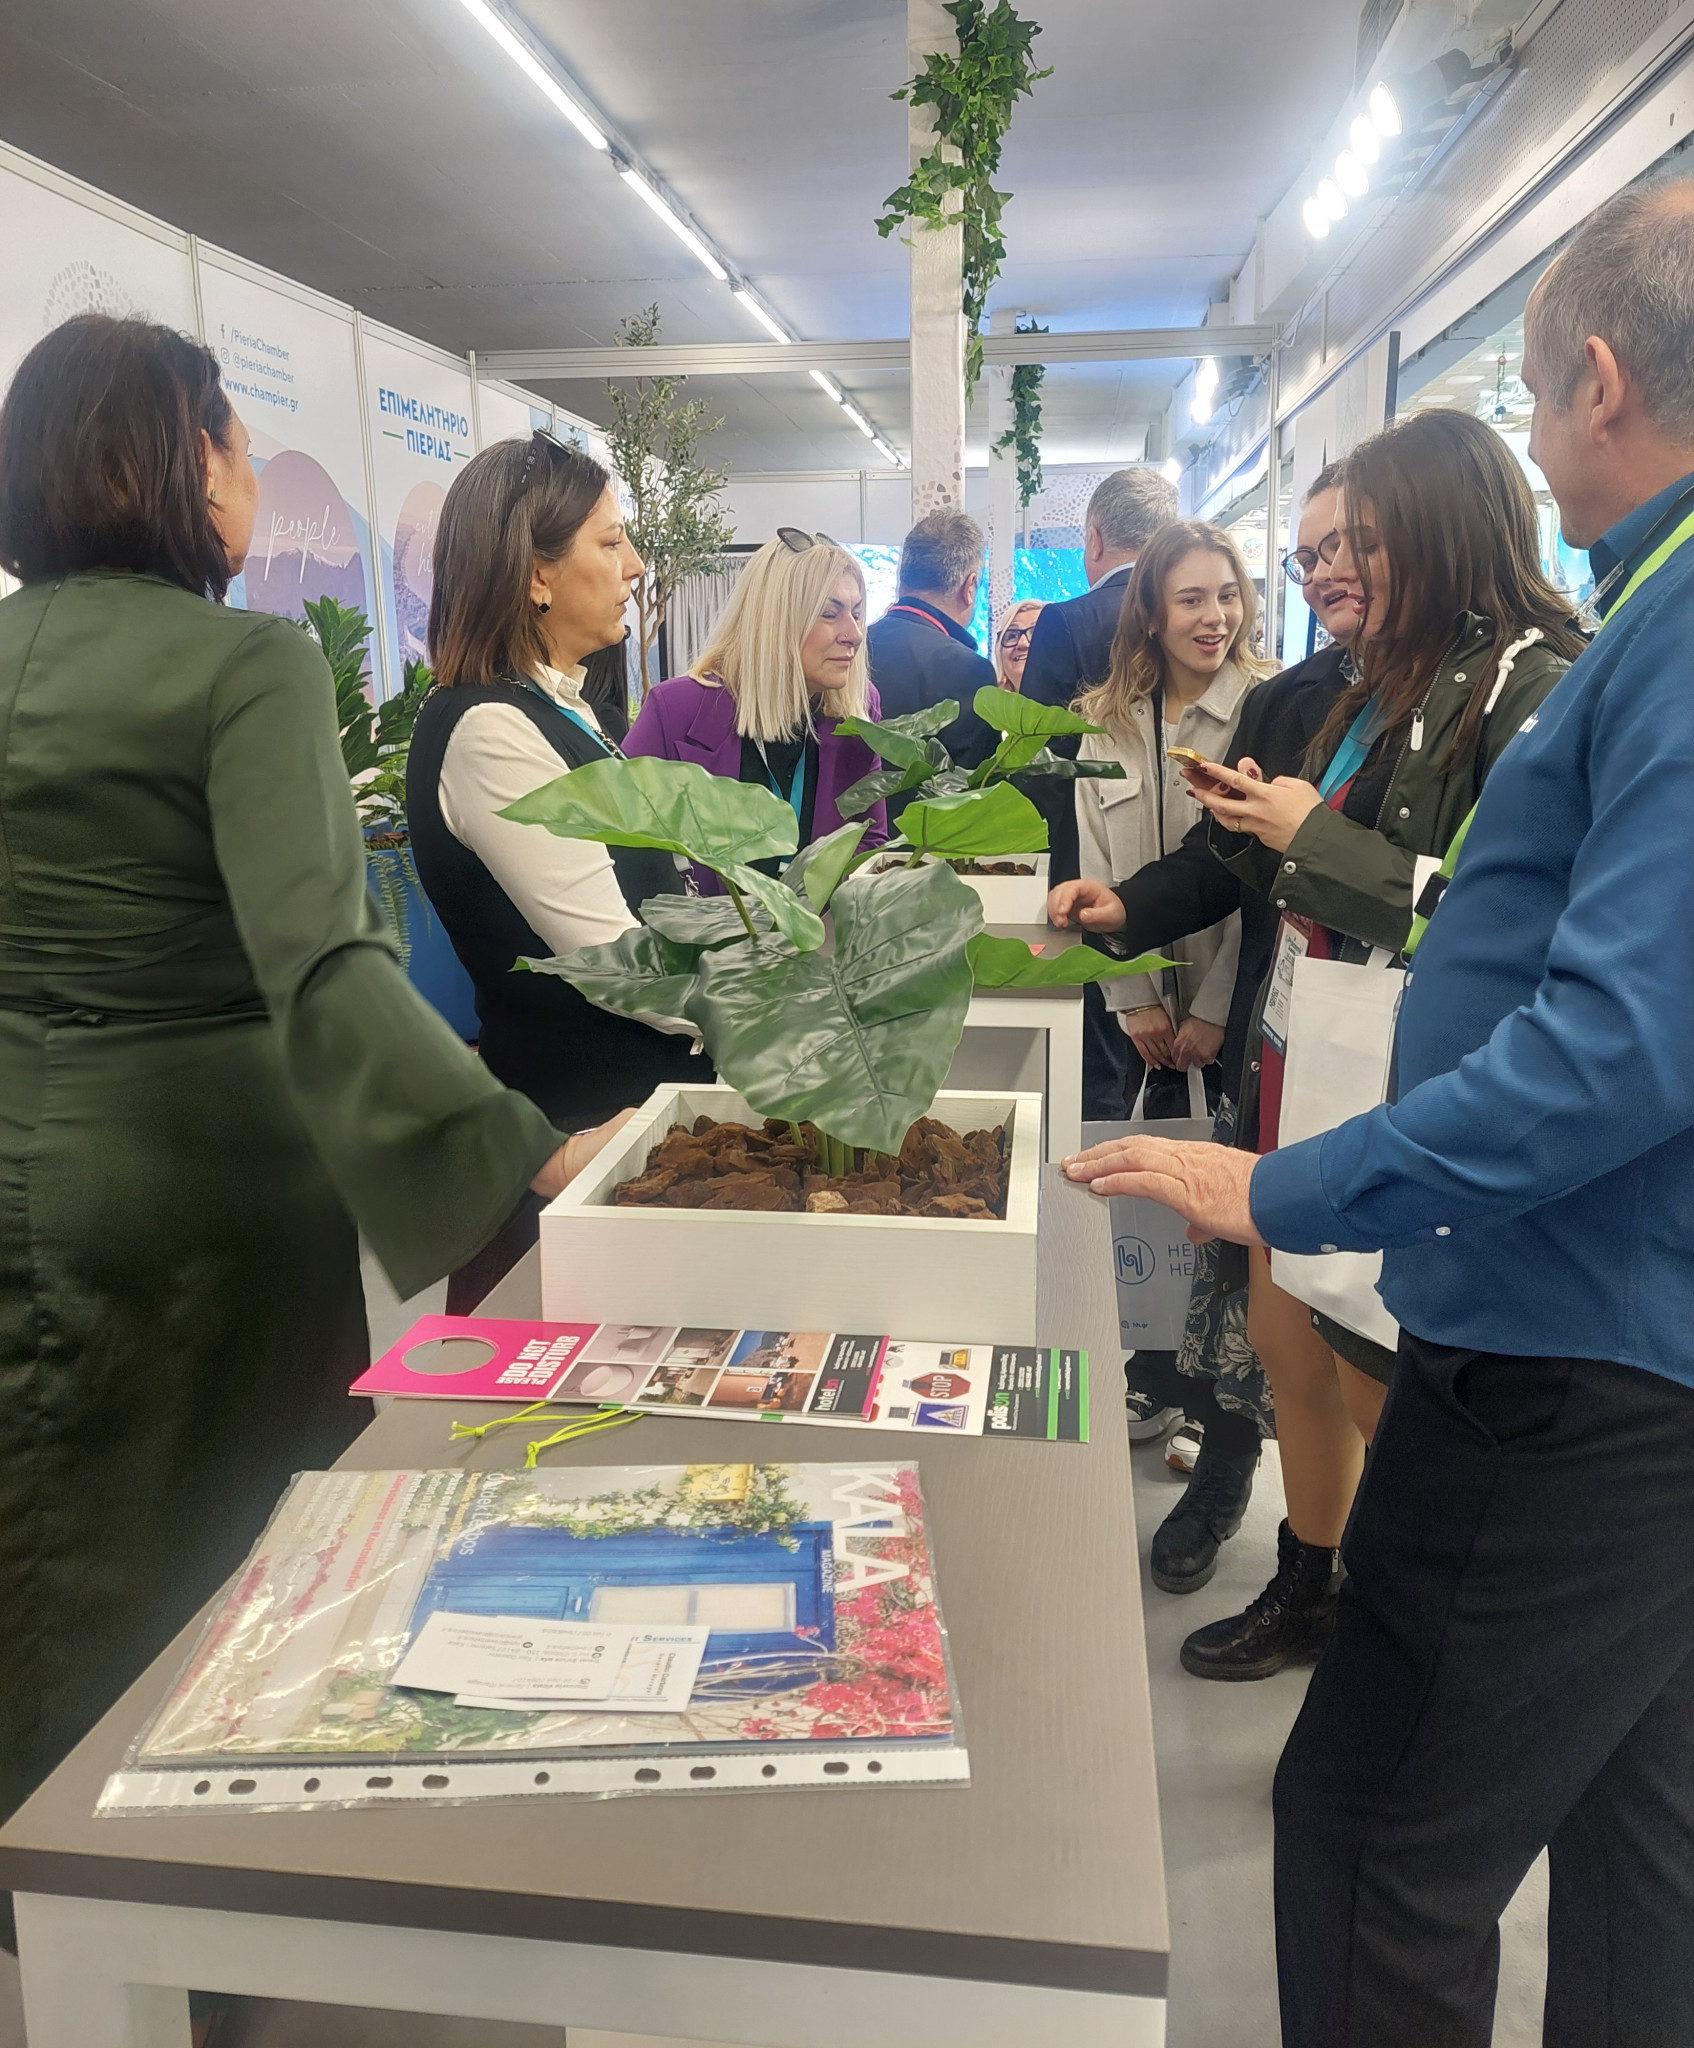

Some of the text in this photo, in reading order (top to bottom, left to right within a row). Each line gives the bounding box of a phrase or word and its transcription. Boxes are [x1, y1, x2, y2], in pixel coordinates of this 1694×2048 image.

[231, 327, 289, 360] /PieriaChamber
[233, 352, 294, 384] @pieriachamber
[224, 379, 299, 412] www.champier.gr
[379, 387, 469, 438] ΕΠΙΜΕΛΗΤΗΡΙΟ
[406, 428, 452, 462] ΠΙΕΡΙΑΣ
[264, 504, 341, 584] people
[1168, 1243, 1193, 1258] HE
[1170, 1262, 1194, 1278] HE
[501, 1338, 551, 1378] DO NOT
[528, 1335, 580, 1378] DISTURB
[494, 1376, 548, 1386] PLEASE
[929, 1375, 953, 1398] STOP
[458, 1512, 493, 1557] Lebos
[830, 1467, 910, 1594] KALA
[821, 1549, 834, 1594] MAGAZINE
